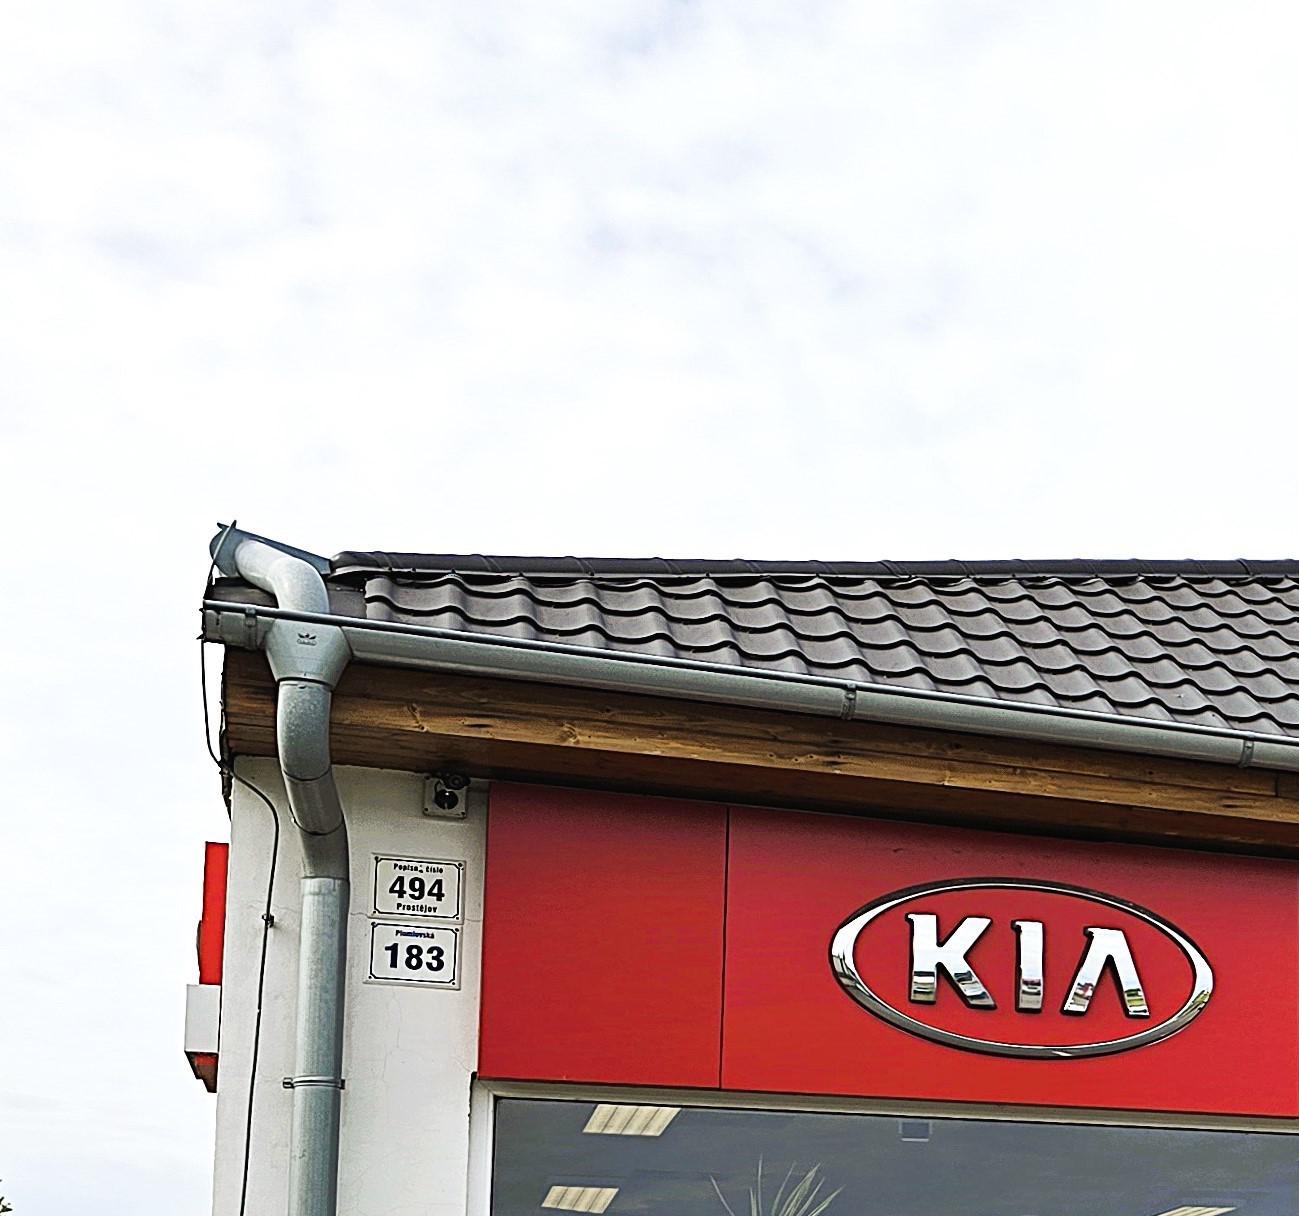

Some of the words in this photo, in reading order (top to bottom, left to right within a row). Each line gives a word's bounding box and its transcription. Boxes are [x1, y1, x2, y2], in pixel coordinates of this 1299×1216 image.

[388, 875, 446, 902] 494
[396, 902, 438, 914] Prostějov
[384, 942, 445, 972] 183
[907, 913, 1150, 1017] KIA
